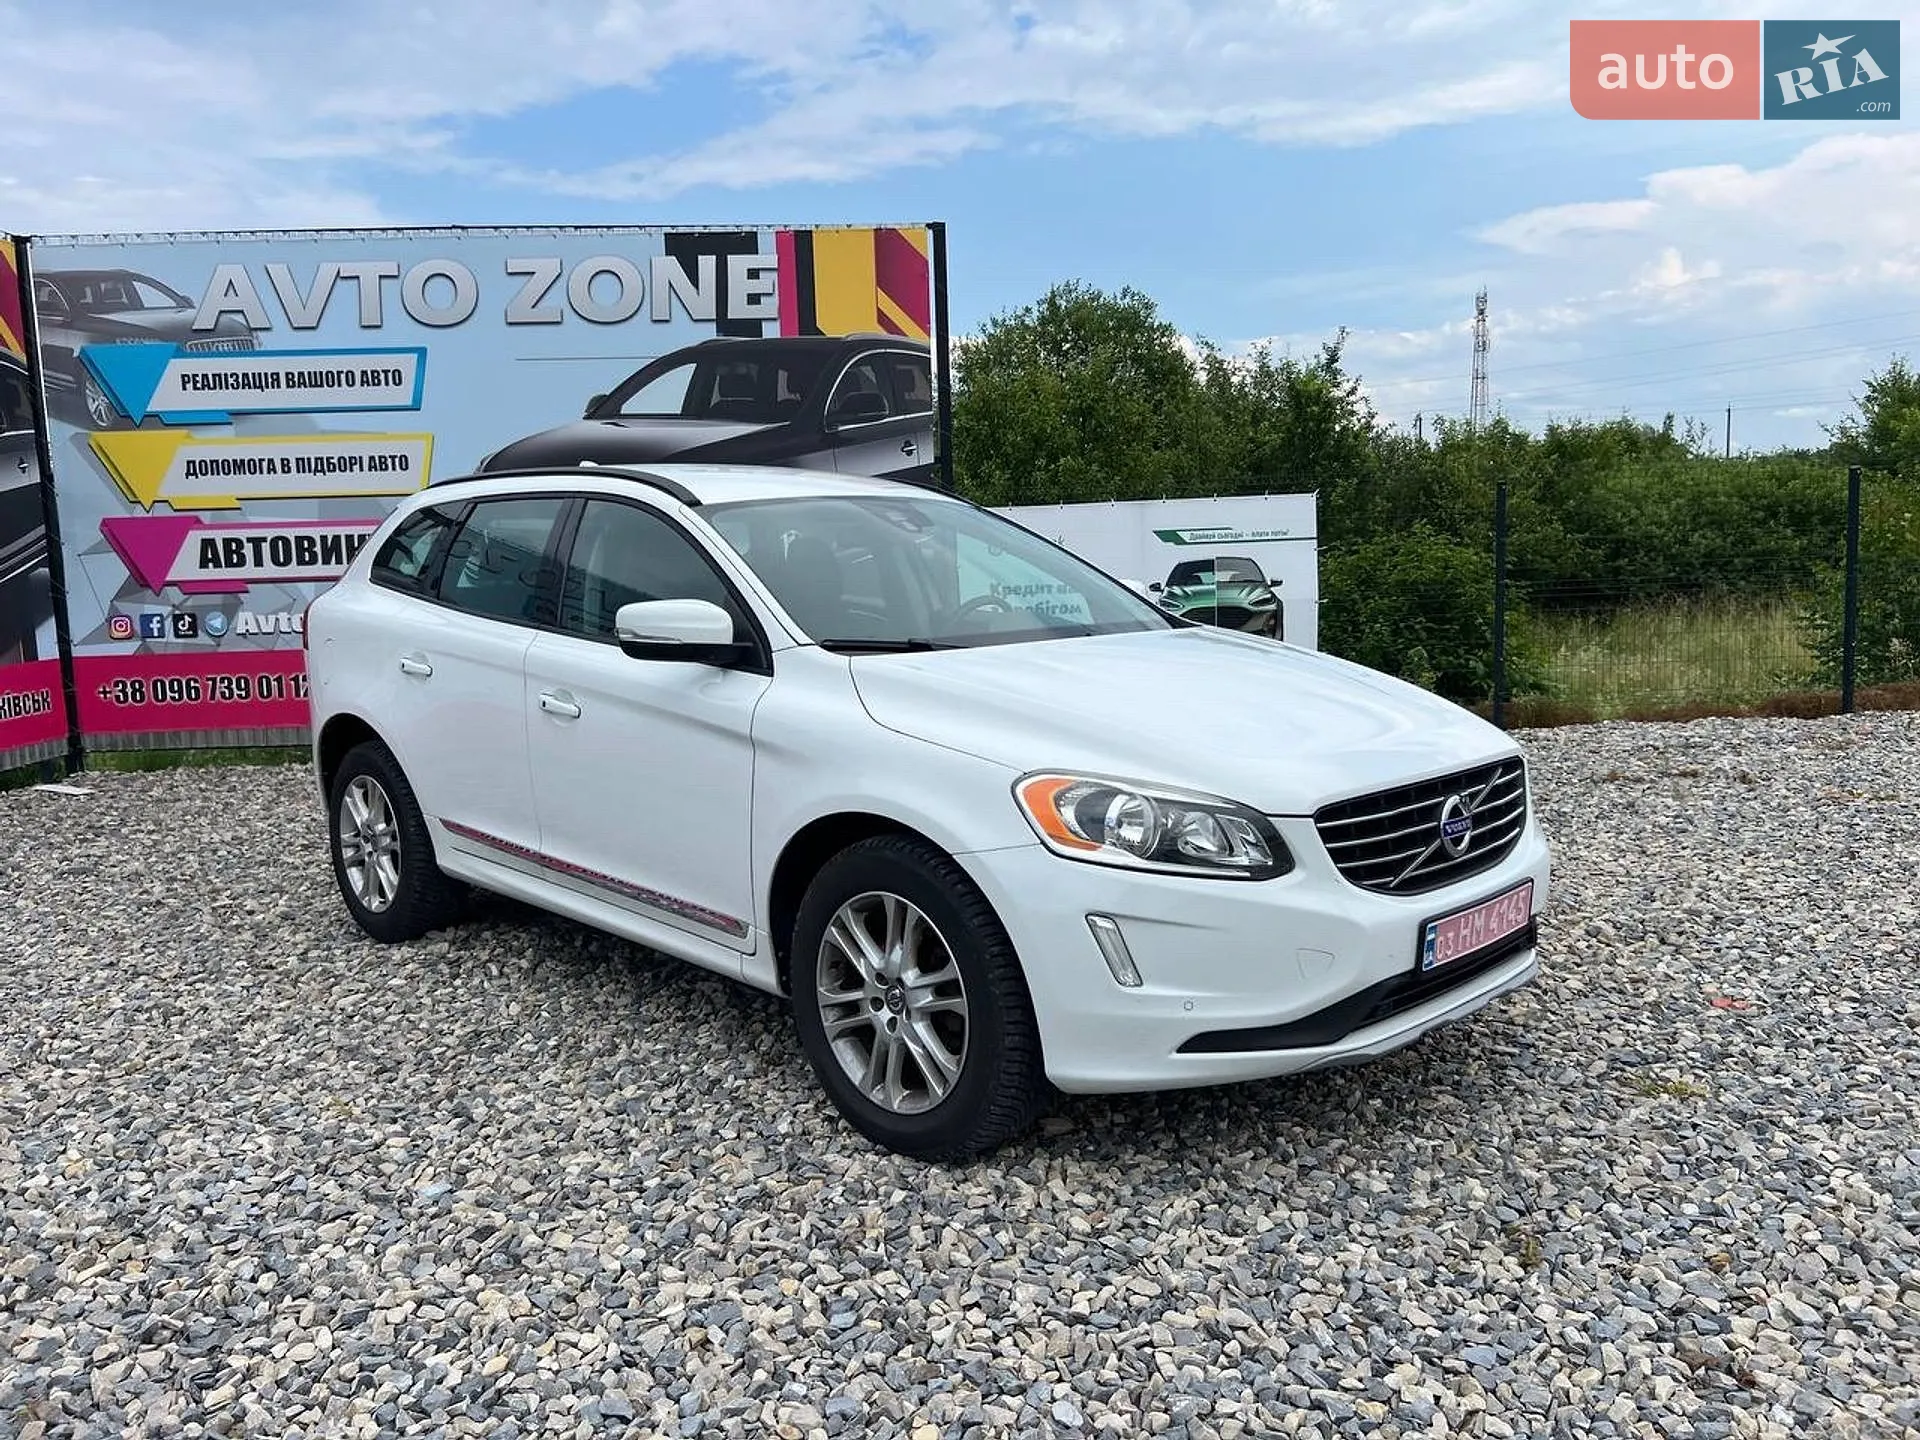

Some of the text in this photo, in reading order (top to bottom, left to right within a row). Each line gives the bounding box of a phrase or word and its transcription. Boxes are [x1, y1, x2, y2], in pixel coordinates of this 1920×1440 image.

[191, 255, 780, 331] AVTO ZONE
[180, 368, 403, 393] РЕАЛІЗАЦІЯ ВАШОГО АВТО
[184, 454, 410, 479] ДОПОМОГА В ПІДБОРІ АВТО
[98, 678, 146, 705] +38
[152, 677, 200, 703] 096
[205, 675, 251, 701] 739
[257, 673, 285, 700] 01
[1436, 931, 1455, 960] 03
[1489, 889, 1526, 934] 4145
